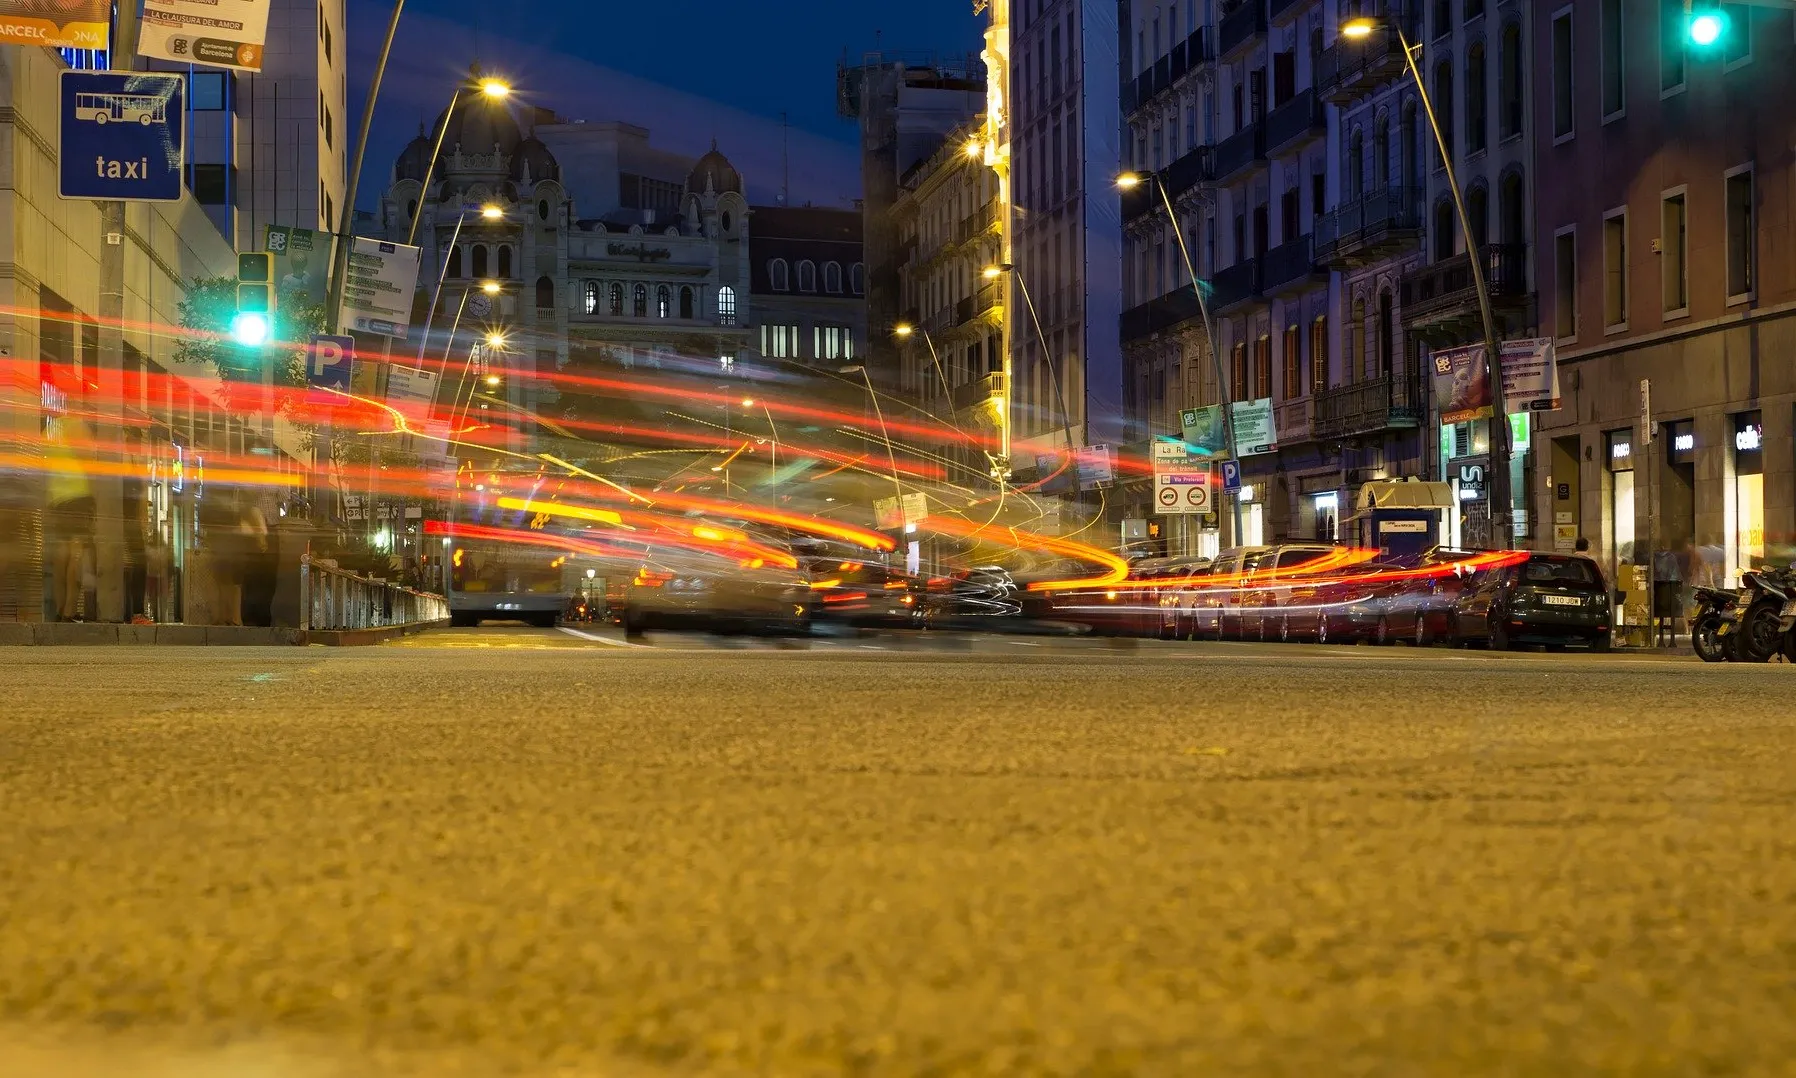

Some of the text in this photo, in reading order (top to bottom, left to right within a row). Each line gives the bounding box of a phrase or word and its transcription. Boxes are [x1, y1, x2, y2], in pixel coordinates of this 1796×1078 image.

[151, 10, 160, 18] LA
[161, 12, 201, 24] CLAUSURA
[218, 21, 241, 29] AMOR
[200, 48, 233, 58] Barcelona
[96, 156, 148, 179] taxi
[314, 340, 343, 376] P
[1162, 446, 1171, 454] La
[1224, 464, 1236, 486] P
[1462, 481, 1483, 489] undiz
[1547, 596, 1565, 604] 1210
